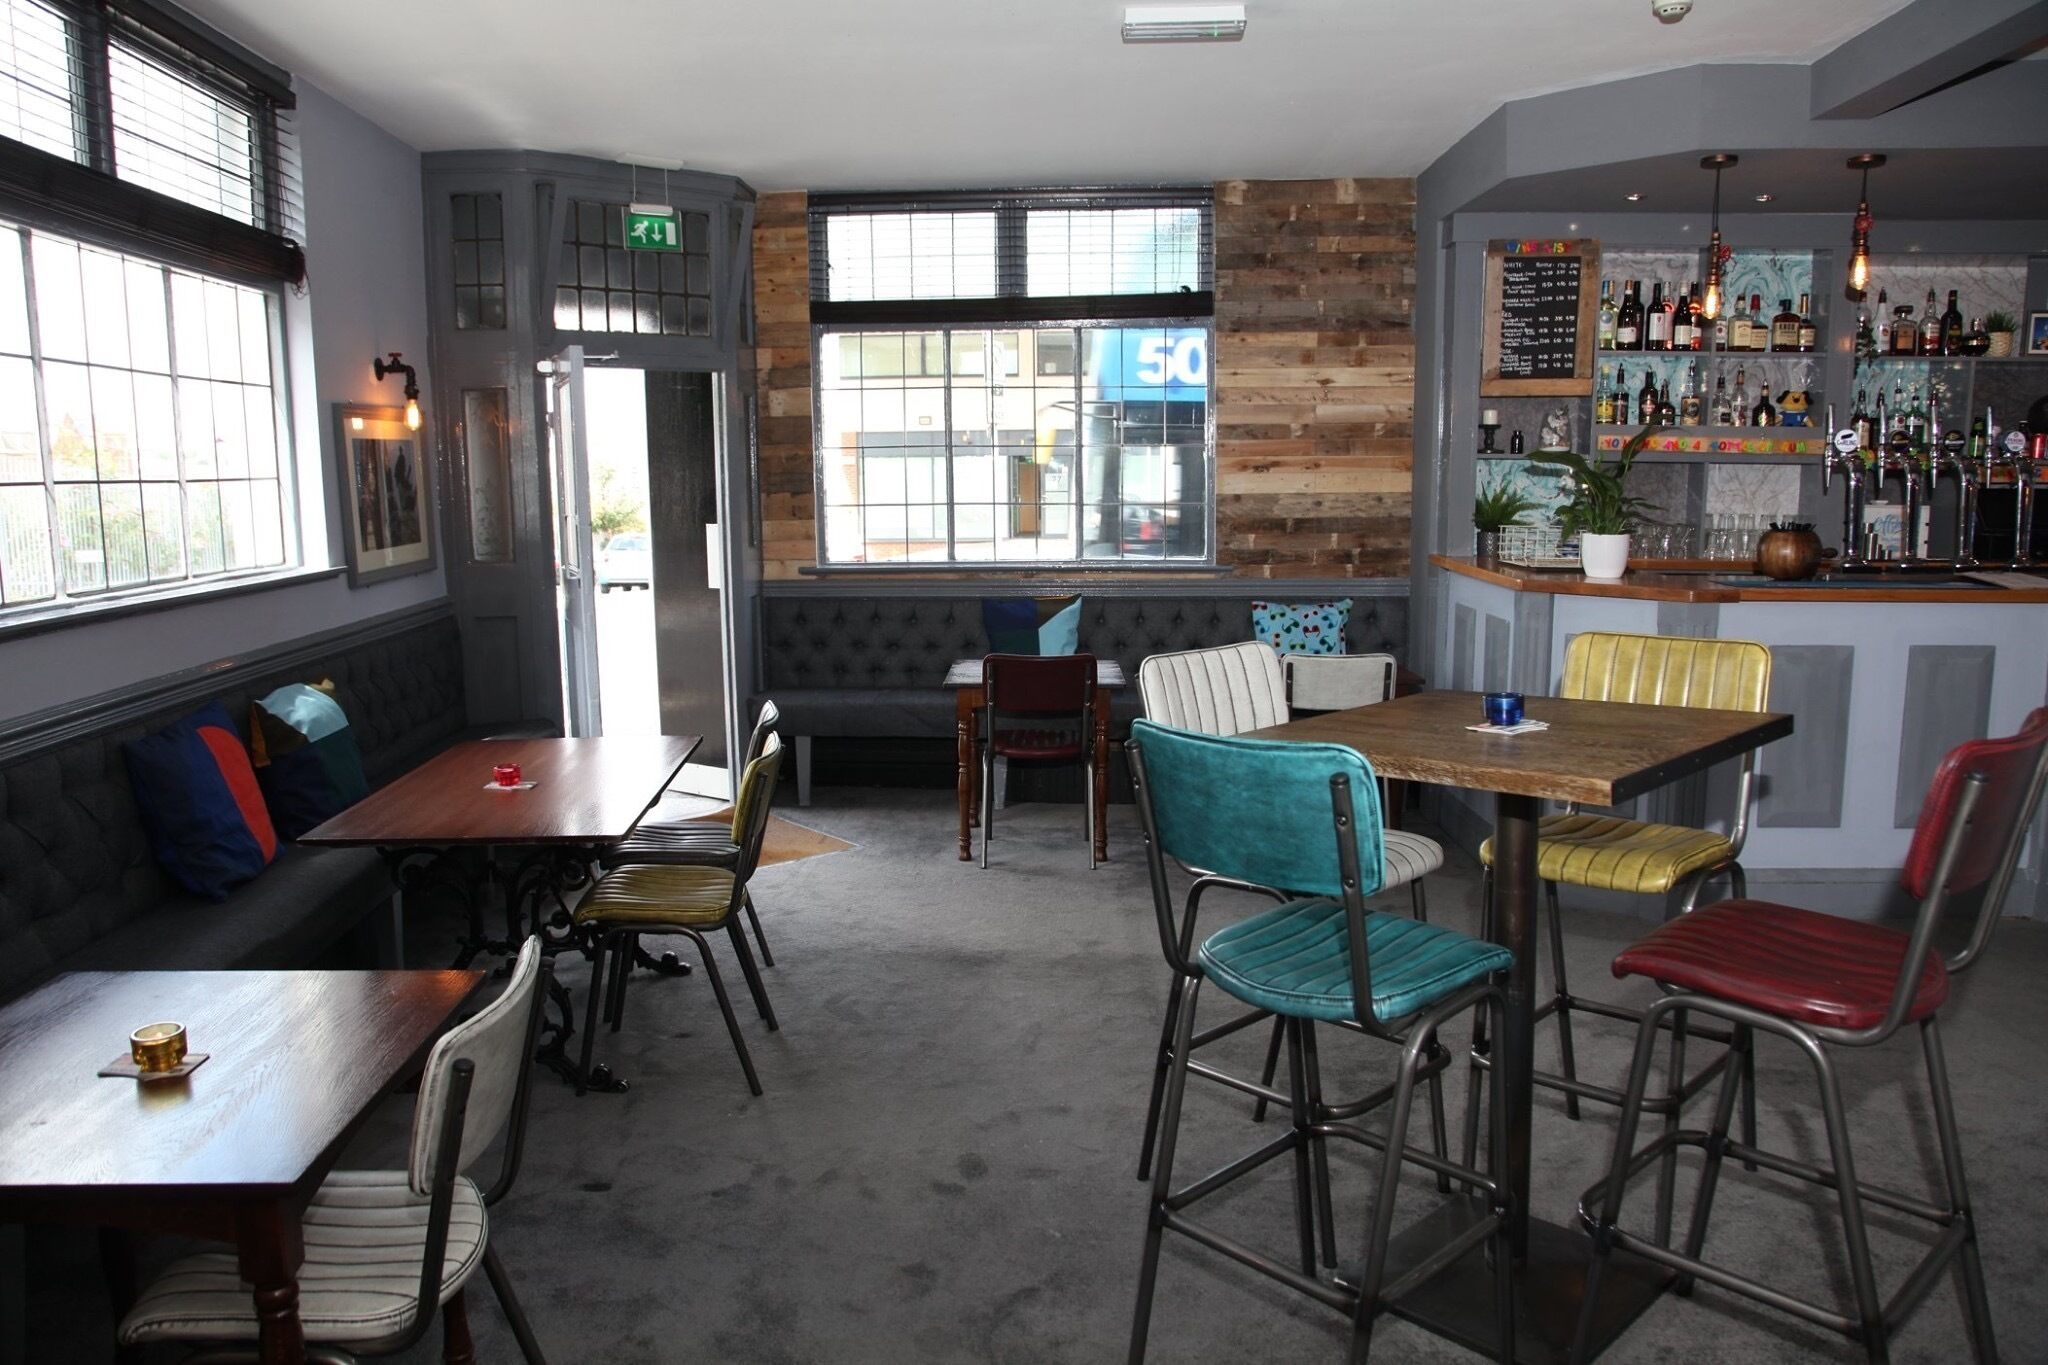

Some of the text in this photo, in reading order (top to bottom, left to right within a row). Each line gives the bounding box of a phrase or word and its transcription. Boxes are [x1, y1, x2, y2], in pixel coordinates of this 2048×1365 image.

[1504, 240, 1572, 254] WINE LIST
[1136, 336, 1207, 385] 50
[1604, 438, 1620, 449] YO
[1664, 438, 1688, 450] AND
[1692, 440, 1701, 450] A
[1780, 440, 1806, 452] RUM
